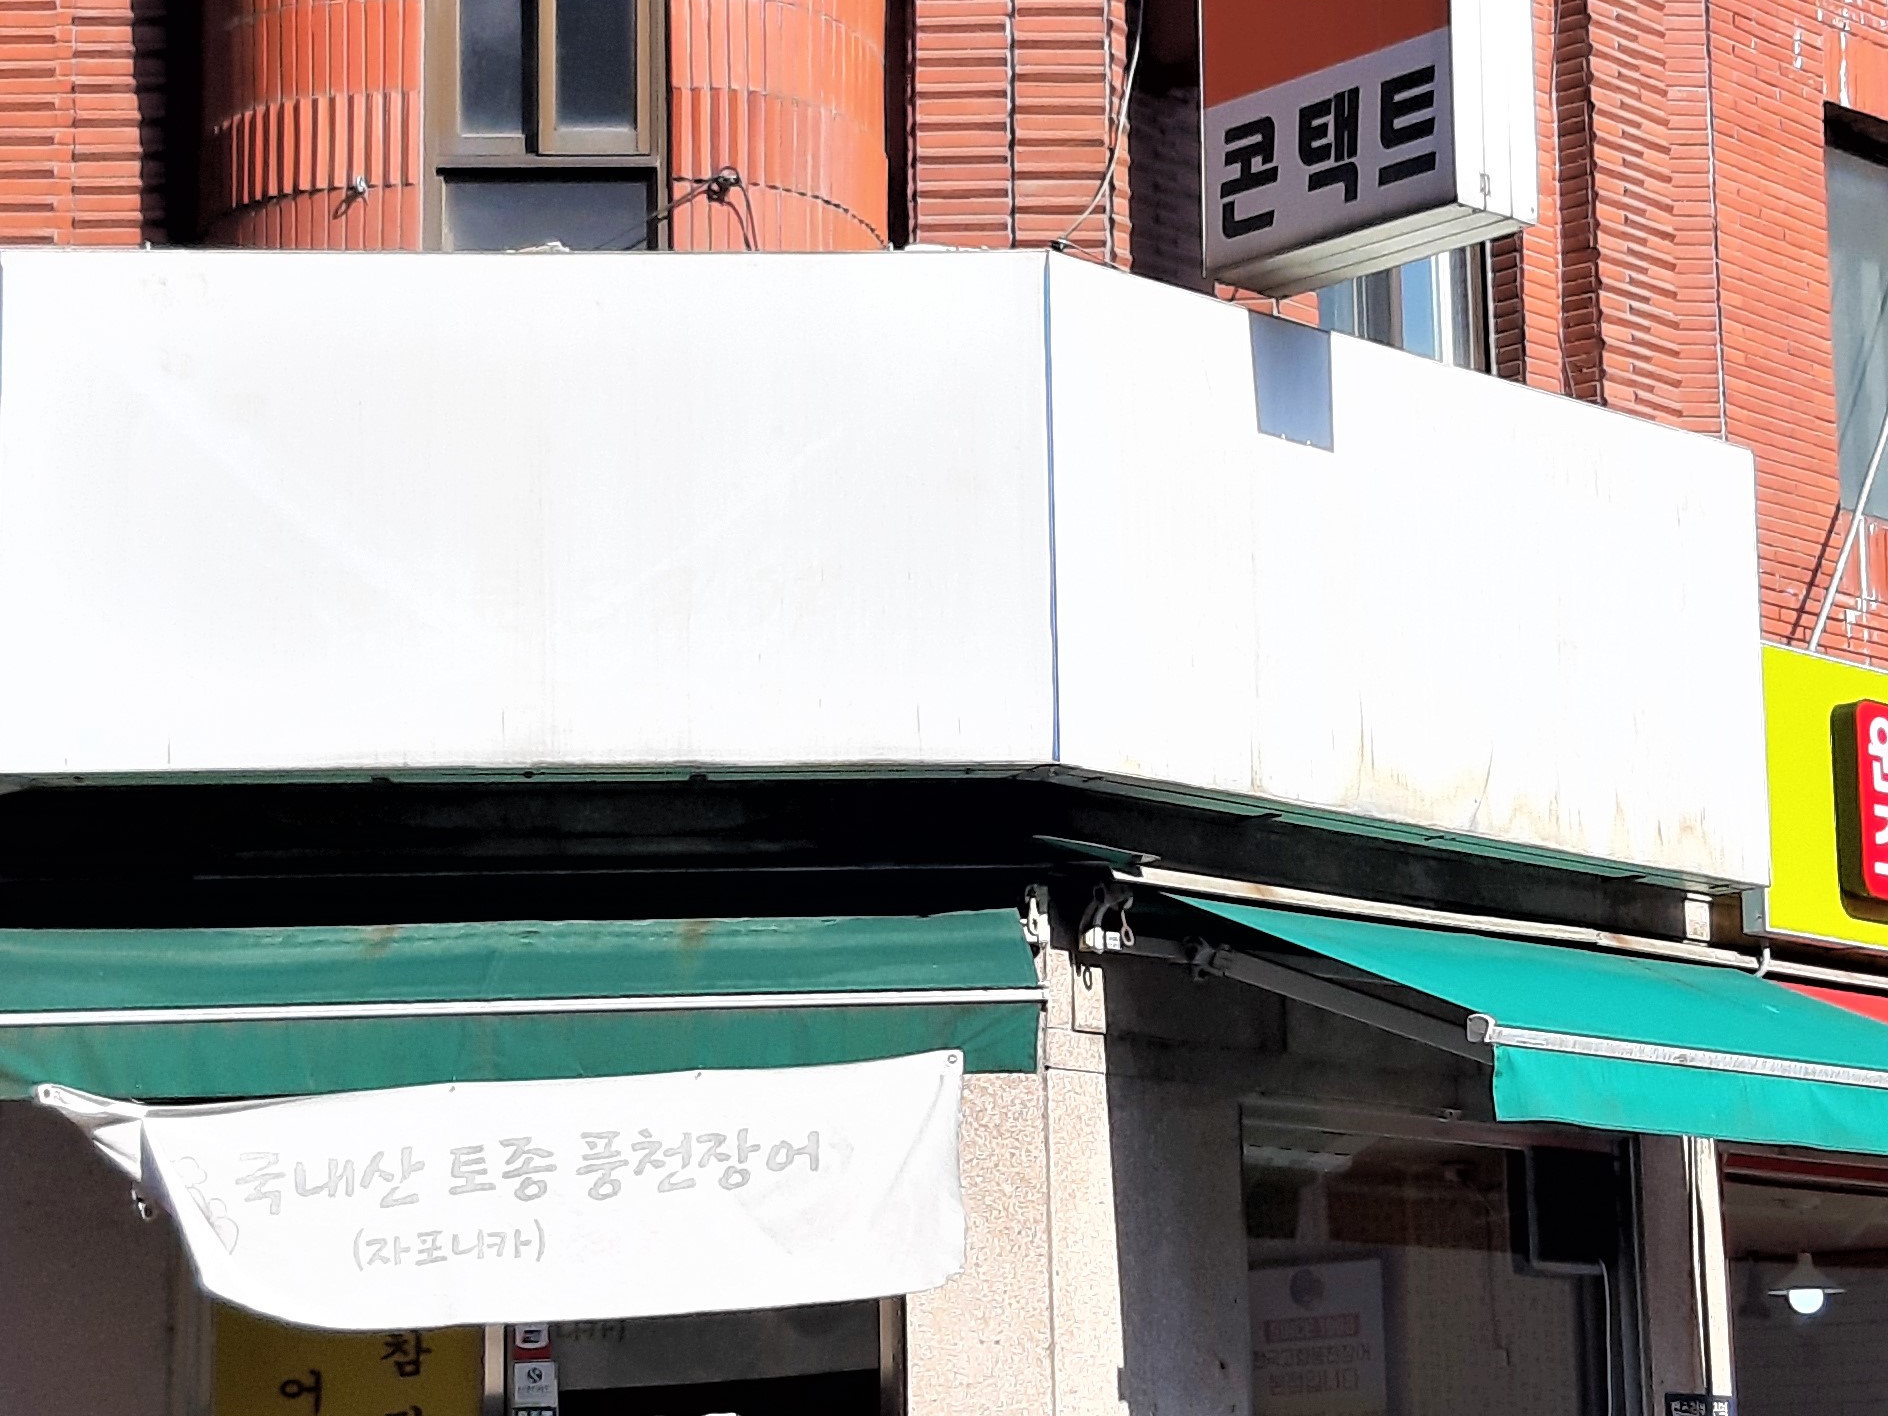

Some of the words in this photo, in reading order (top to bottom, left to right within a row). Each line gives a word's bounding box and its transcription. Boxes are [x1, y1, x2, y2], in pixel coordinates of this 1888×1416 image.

[1219, 64, 1437, 240] 콘택트
[234, 1144, 424, 1215] 국내산
[448, 1136, 556, 1201] 토종
[574, 1128, 822, 1201] 풍천장어
[352, 1227, 547, 1272] (자포니카)
[381, 1329, 433, 1378] 참
